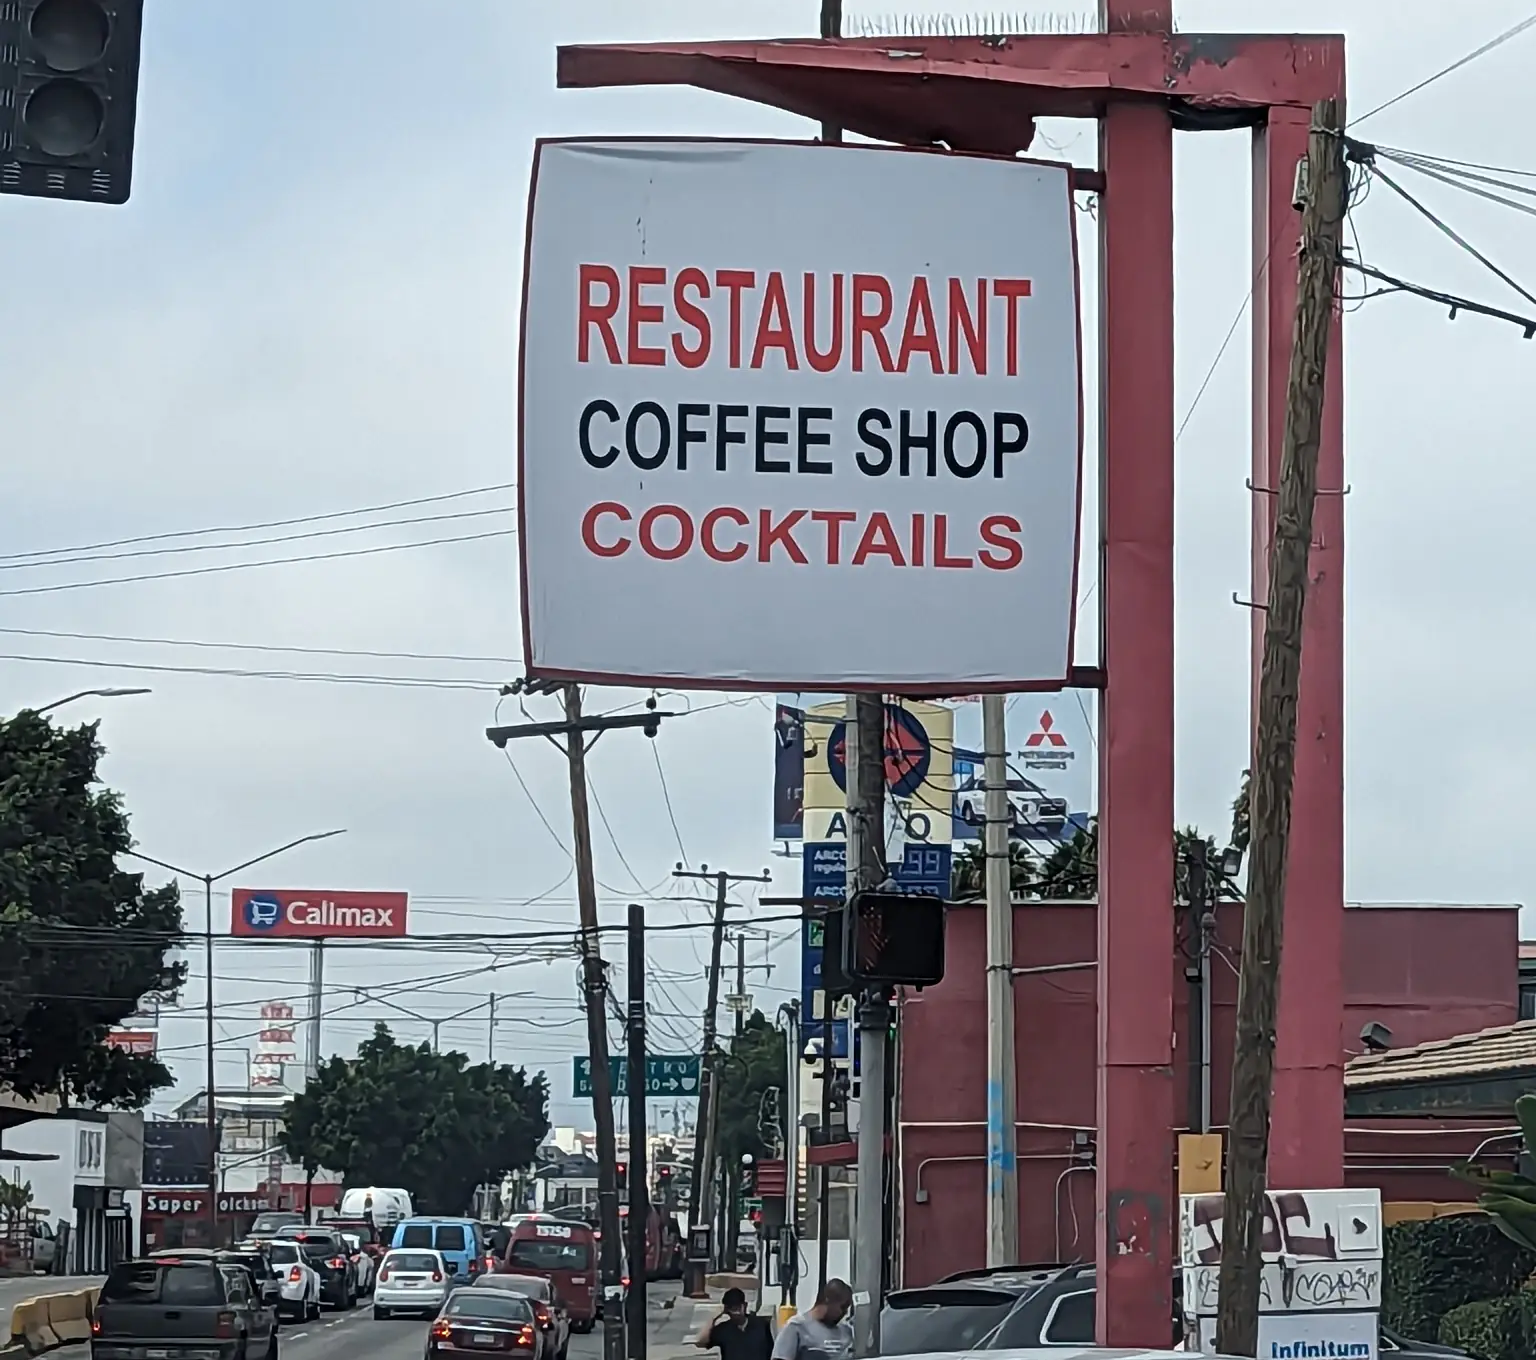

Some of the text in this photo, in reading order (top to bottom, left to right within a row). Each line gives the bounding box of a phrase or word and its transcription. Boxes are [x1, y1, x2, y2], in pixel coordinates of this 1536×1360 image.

[577, 263, 1032, 377] RESTAURANT
[578, 399, 1030, 479] COFFEE SHOP
[580, 501, 1024, 571] COCKTAILS
[286, 900, 394, 927] Calimax
[147, 1196, 202, 1214] Super
